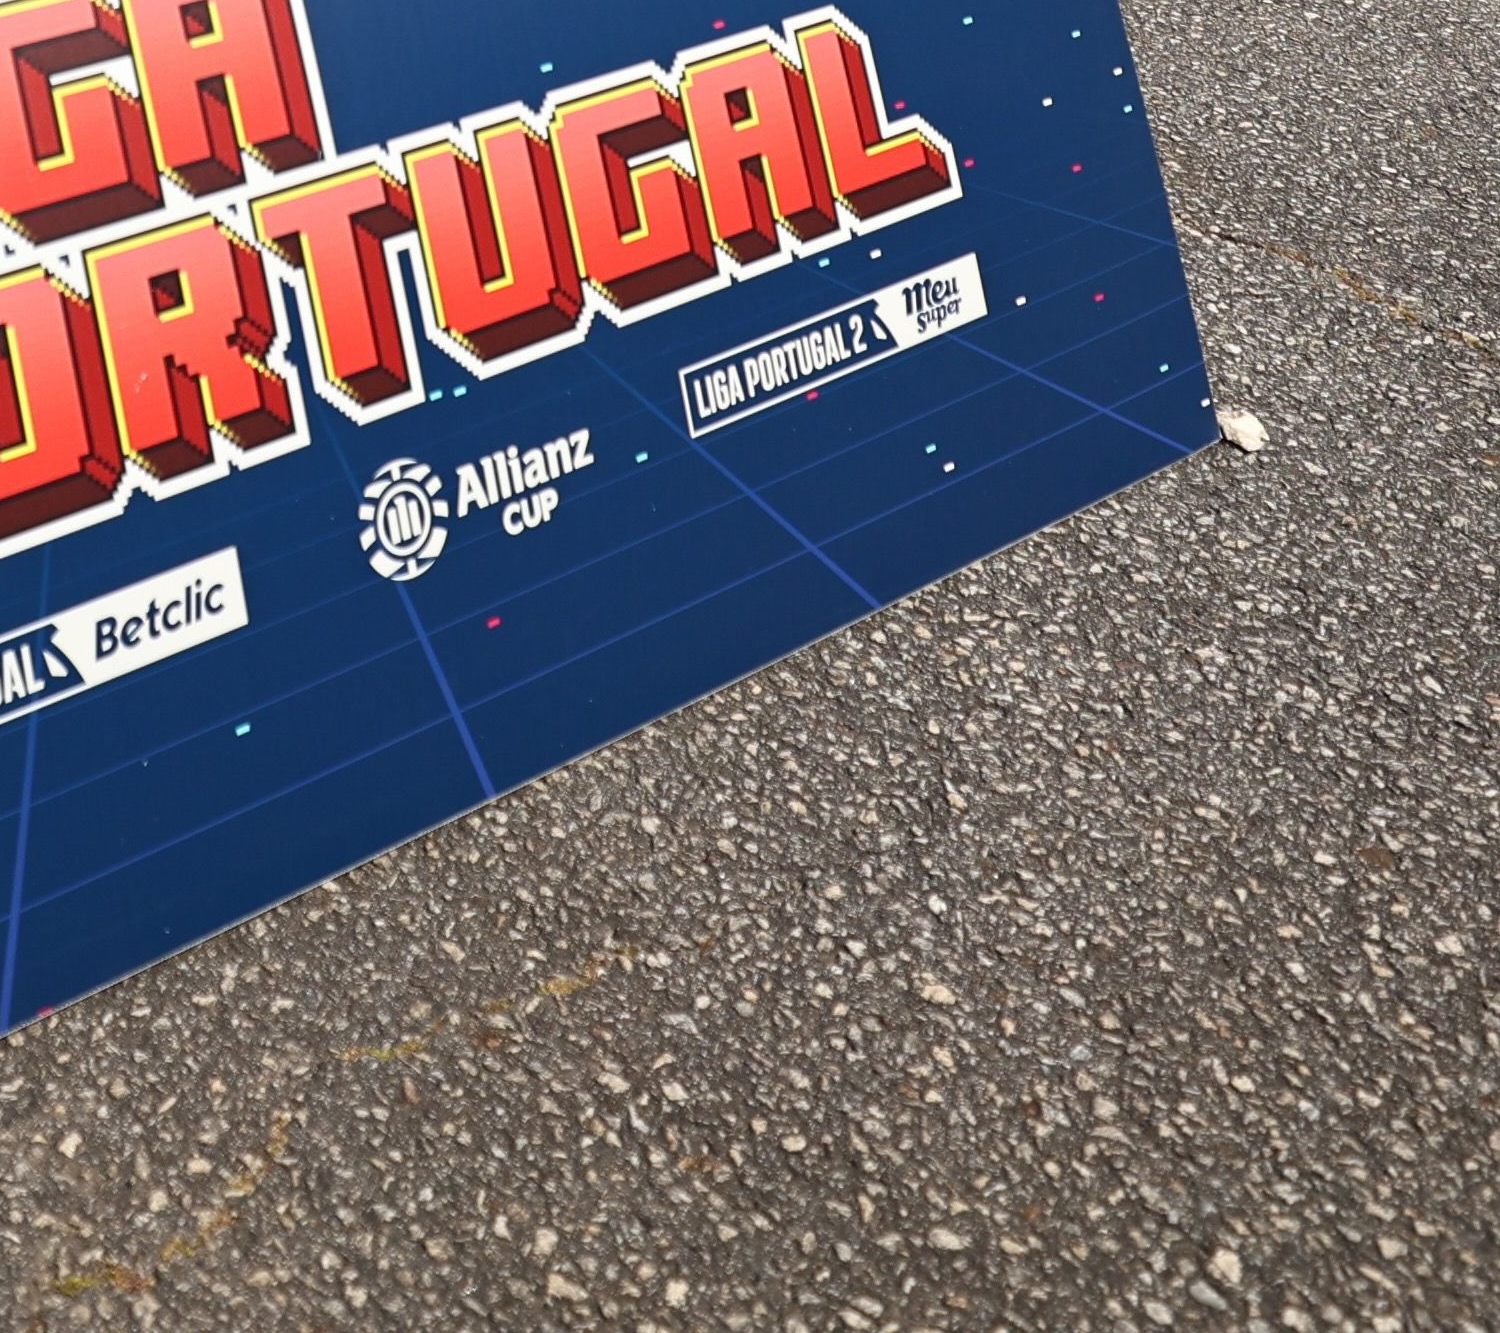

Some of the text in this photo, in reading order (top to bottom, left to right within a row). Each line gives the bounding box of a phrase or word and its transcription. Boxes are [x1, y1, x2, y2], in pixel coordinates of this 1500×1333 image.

[902, 277, 959, 315] Meu
[917, 298, 961, 334] super
[693, 314, 867, 419] LIGA PORTUGAL 2
[456, 428, 594, 517] Allianz
[502, 487, 559, 535] CUP
[94, 578, 225, 662] Betclic
